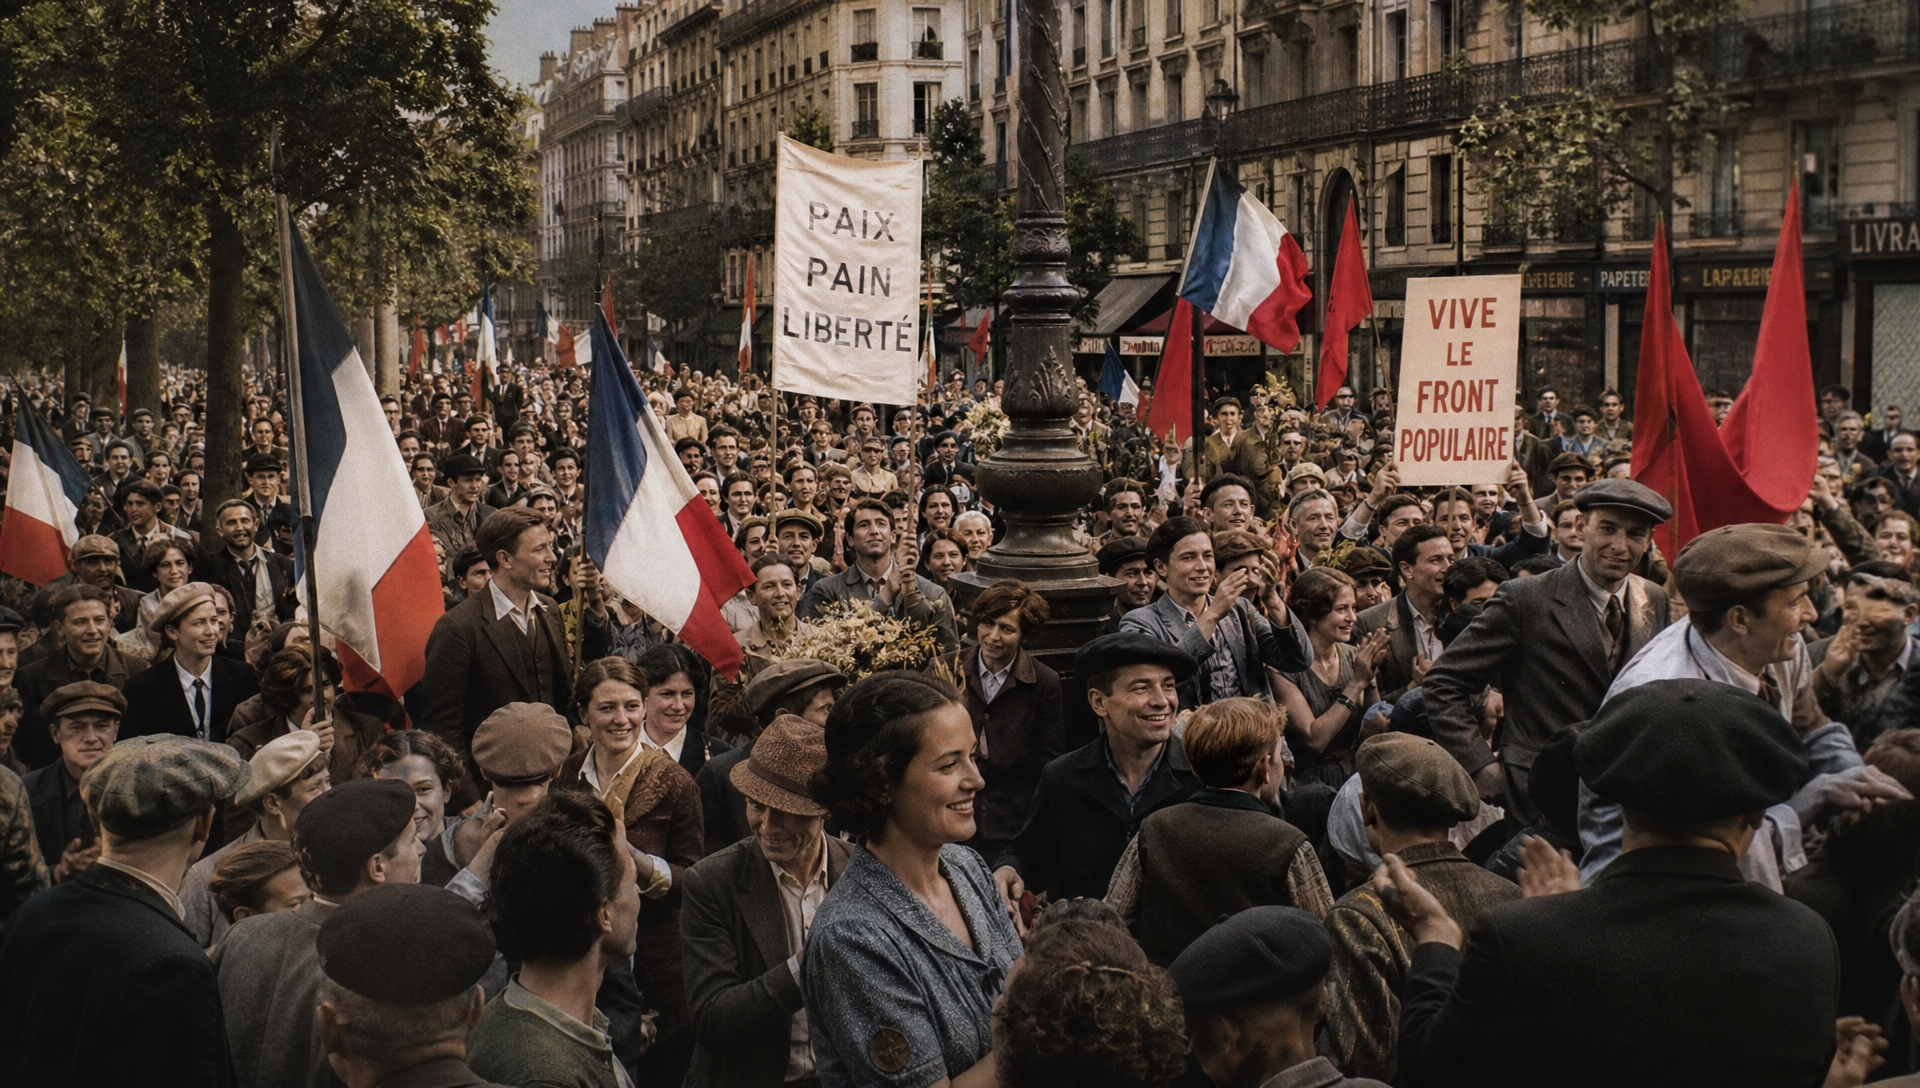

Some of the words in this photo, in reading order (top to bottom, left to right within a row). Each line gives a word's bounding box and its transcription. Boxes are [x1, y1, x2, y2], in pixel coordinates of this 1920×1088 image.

[809, 200, 895, 242] PAIX
[1851, 221, 1920, 253] LIVRA
[806, 256, 891, 297] PAIN
[783, 306, 913, 353] LIBERTÉ
[1428, 297, 1498, 330] VIVE
[1446, 341, 1474, 367] LE
[1416, 378, 1499, 414] FRONT
[1399, 426, 1509, 463] POPULAIRE
